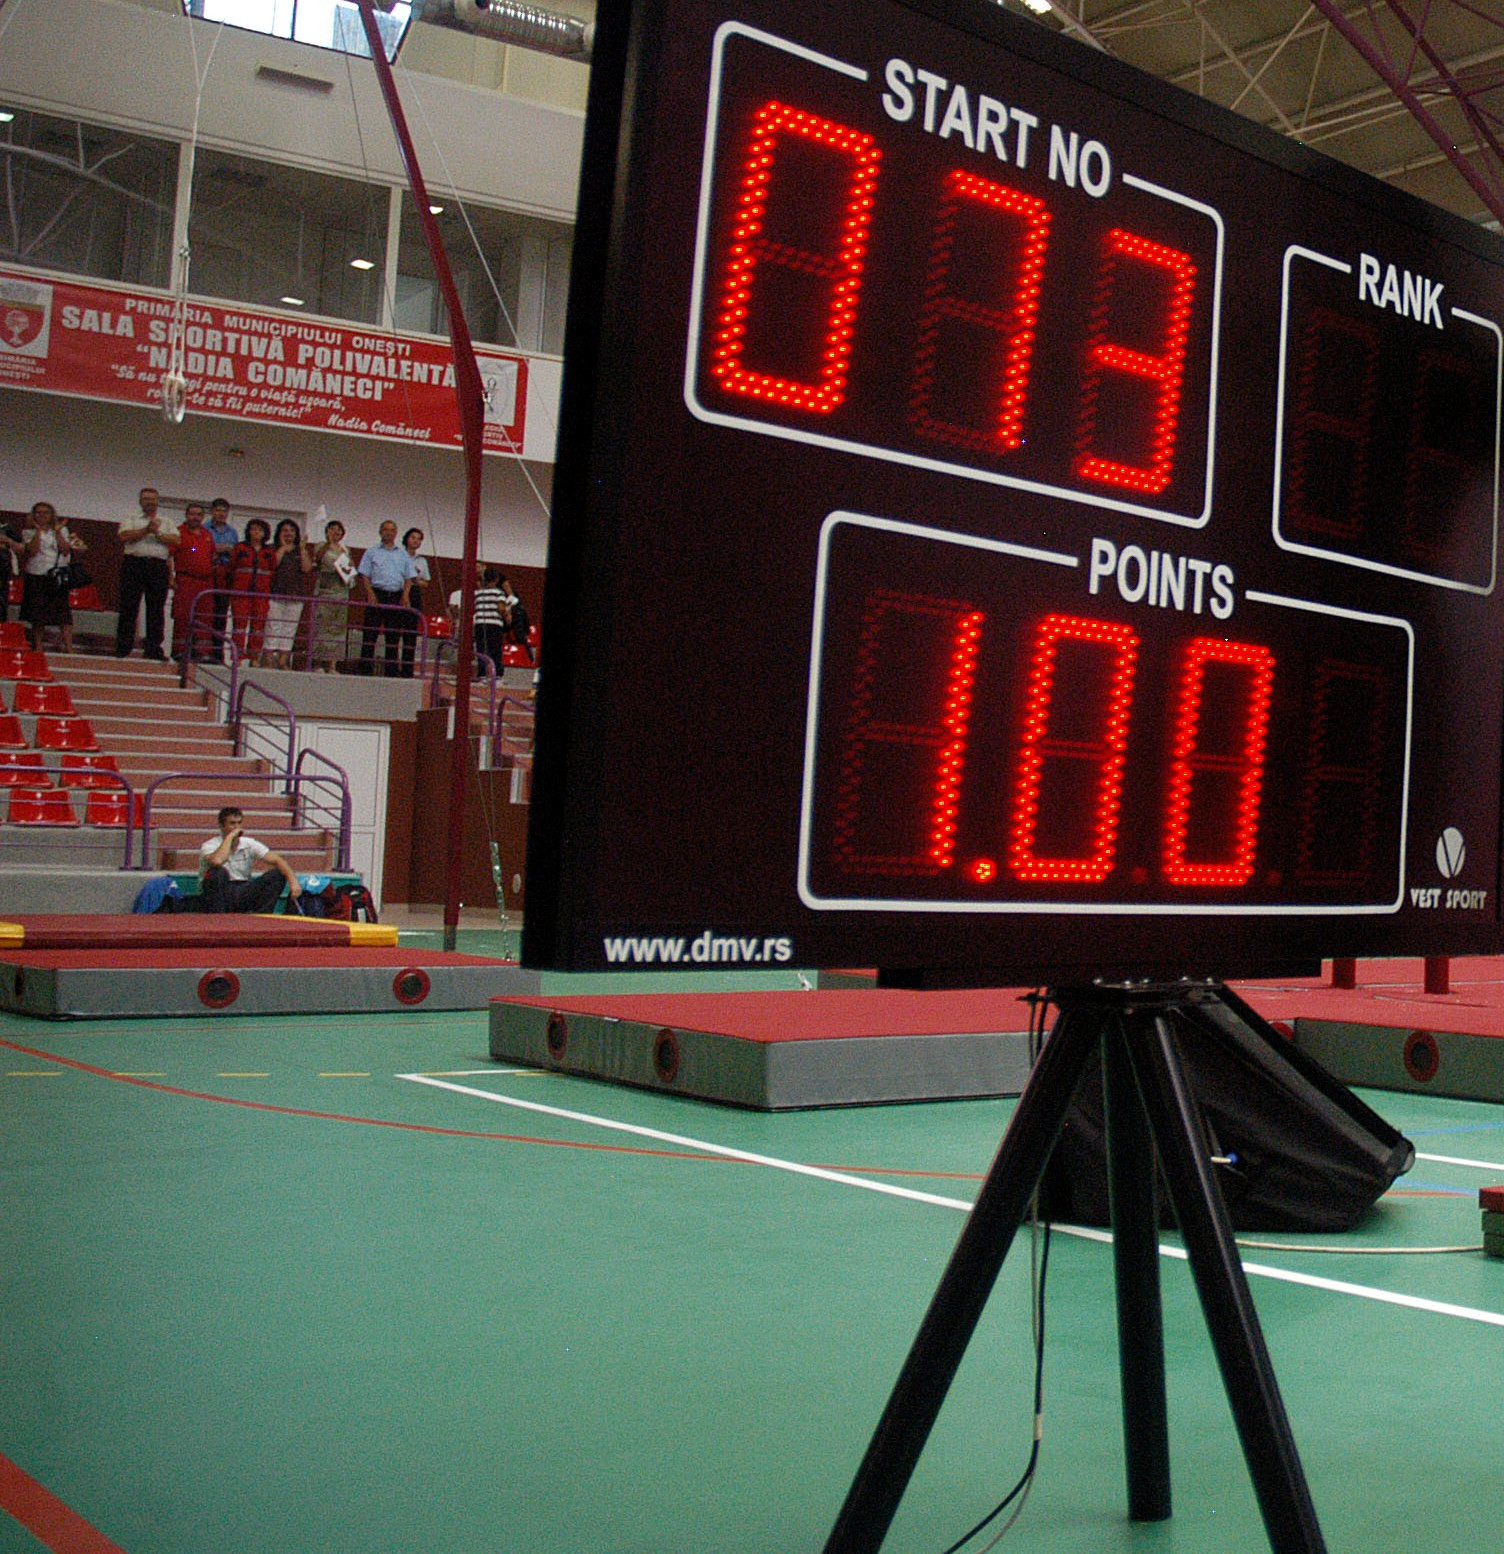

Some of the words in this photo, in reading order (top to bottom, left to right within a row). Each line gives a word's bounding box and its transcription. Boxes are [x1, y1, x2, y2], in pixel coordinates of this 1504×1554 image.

[882, 57, 1038, 170] START
[1048, 123, 1111, 198] NO
[711, 99, 1198, 495] 073
[1358, 252, 1445, 330] RANK
[61, 306, 134, 338] SALA
[224, 315, 342, 345] MUNICIPIULUI
[202, 381, 248, 396] pentru
[327, 413, 368, 430] Nadia
[1089, 537, 1234, 620] POINTS
[1410, 888, 1442, 909] VEST
[1446, 889, 1488, 909] SPORT
[603, 930, 793, 963] www.dmv.rs
